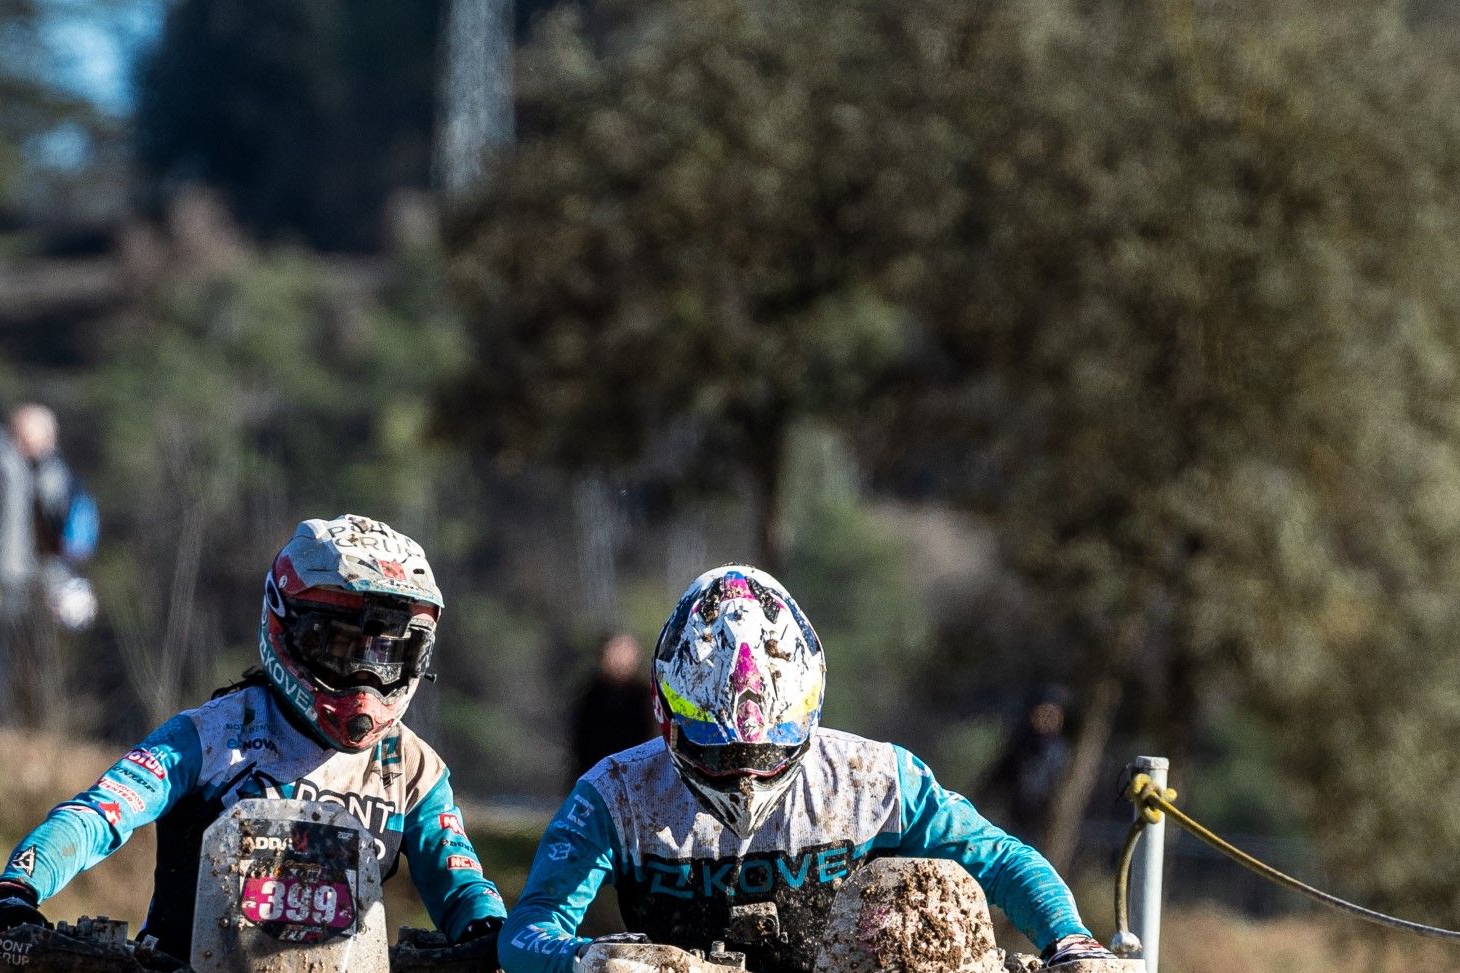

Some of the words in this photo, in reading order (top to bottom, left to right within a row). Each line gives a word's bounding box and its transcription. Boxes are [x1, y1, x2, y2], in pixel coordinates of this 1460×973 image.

[296, 783, 394, 834] PNT
[702, 847, 849, 898] KOVE
[258, 881, 337, 924] 399
